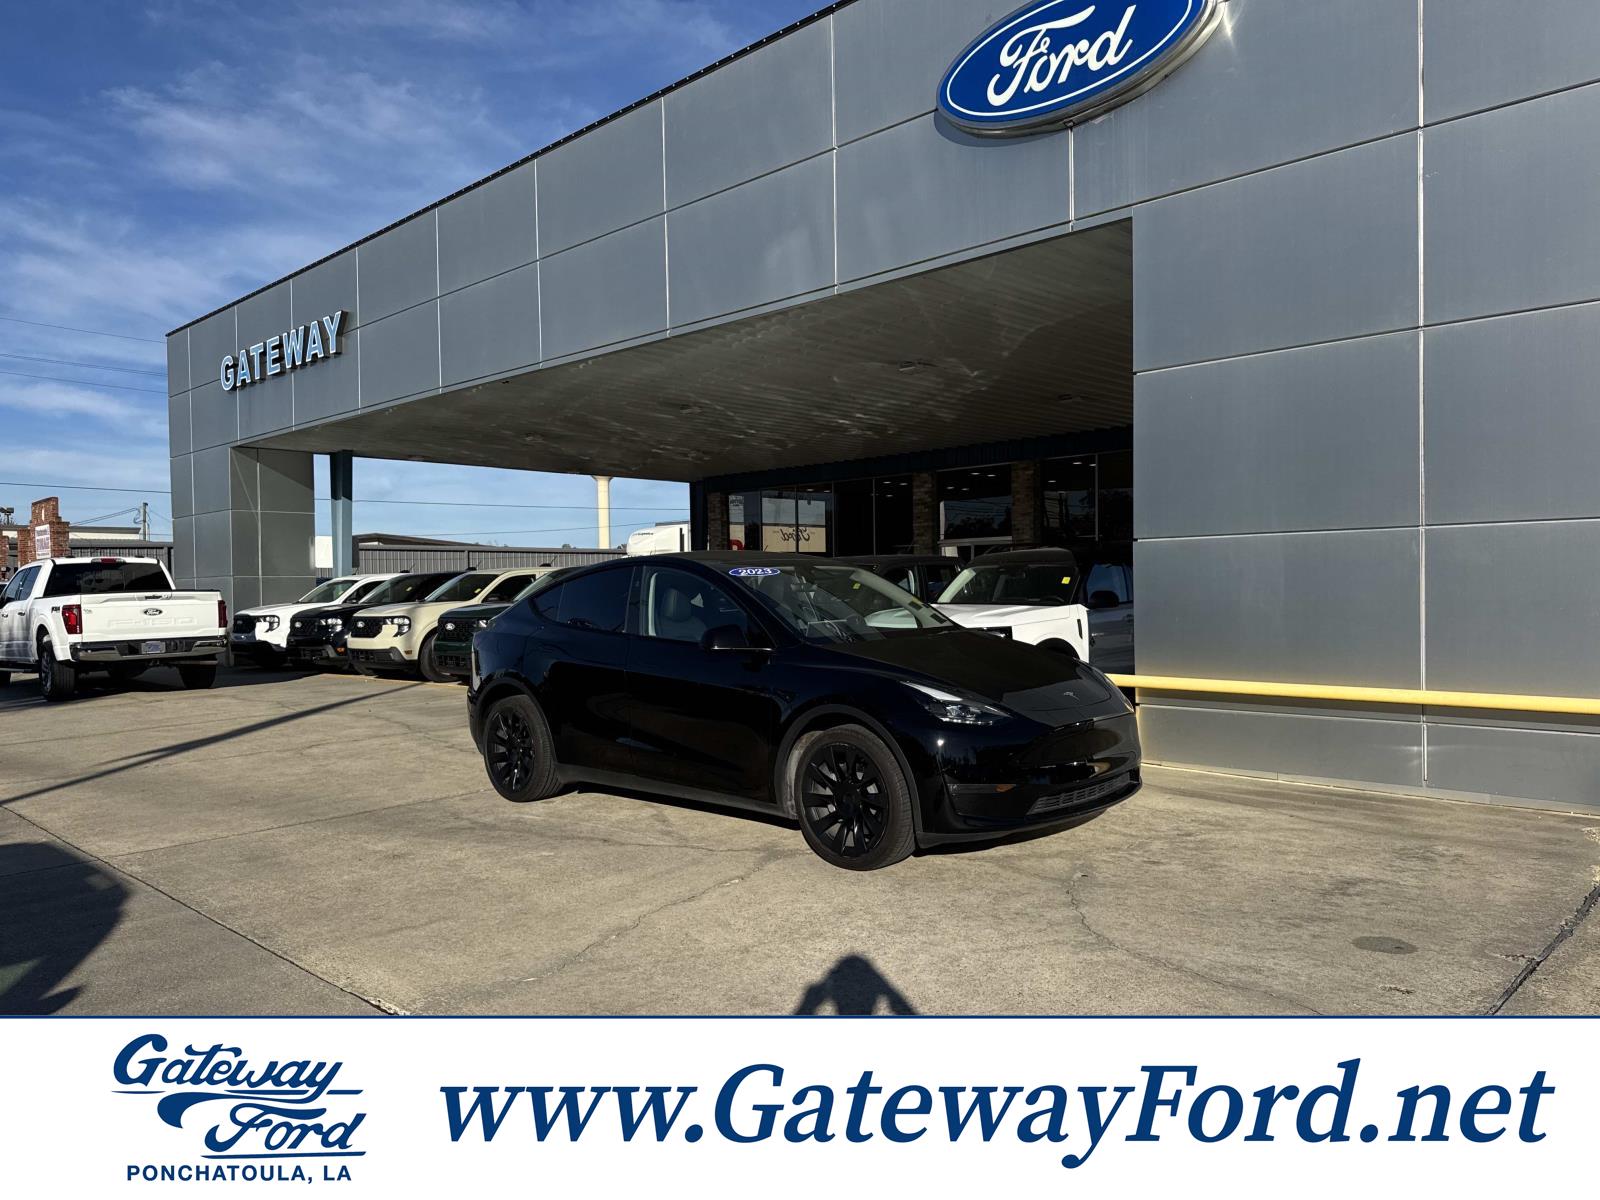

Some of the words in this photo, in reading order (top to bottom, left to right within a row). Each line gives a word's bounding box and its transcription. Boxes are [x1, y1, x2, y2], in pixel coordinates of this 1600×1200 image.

[987, 5, 1136, 106] Ford
[220, 310, 345, 391] GATEWAY
[738, 567, 772, 576] 2023
